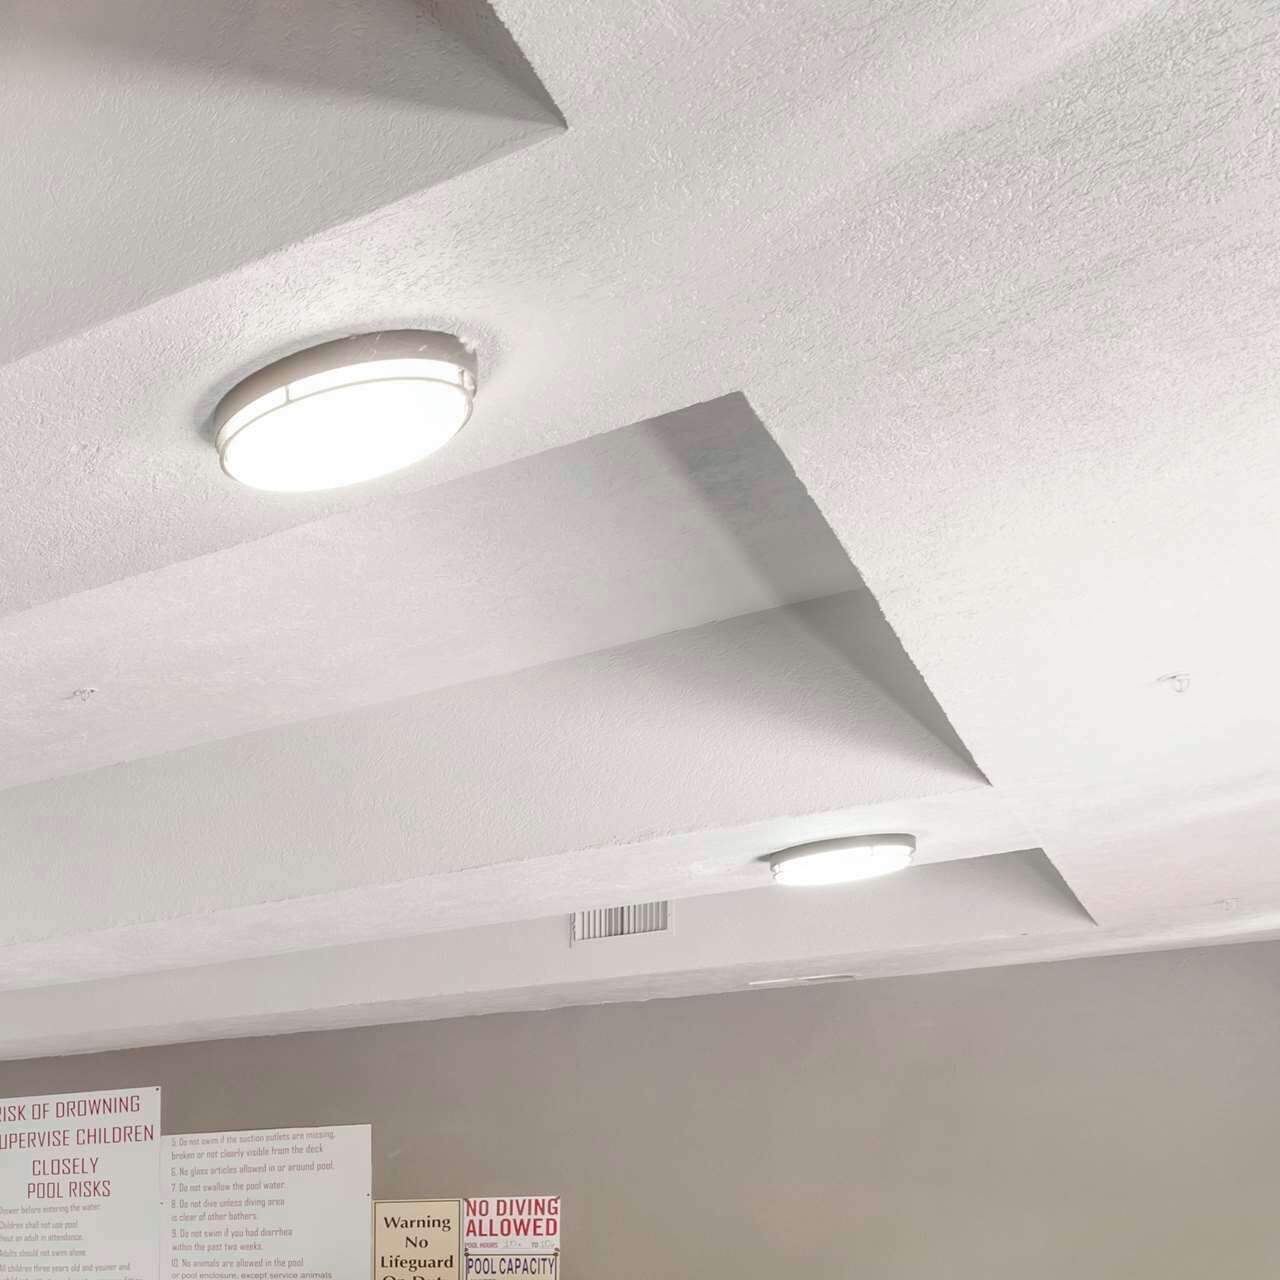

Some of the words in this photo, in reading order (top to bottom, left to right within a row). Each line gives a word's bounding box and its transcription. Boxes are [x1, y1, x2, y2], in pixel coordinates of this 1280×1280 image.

[32, 1103, 50, 1120] OF
[56, 1095, 140, 1118] DROWNING
[77, 1125, 154, 1145] CHILDREN
[171, 1151, 195, 1160] broken
[207, 1150, 218, 1158] not
[220, 1148, 244, 1159] clearly
[246, 1147, 269, 1157] visible
[271, 1147, 290, 1155] from
[291, 1145, 303, 1154] the
[32, 1157, 99, 1176] CLOSELY
[277, 1164, 286, 1172] or
[288, 1161, 314, 1171] around
[28, 1182, 63, 1199] POOL
[69, 1180, 111, 1197] RISKS
[190, 1183, 201, 1191] not
[232, 1181, 244, 1191] the
[246, 1180, 261, 1191] pool
[190, 1199, 201, 1208] not
[466, 1200, 489, 1216] NO
[496, 1198, 558, 1216] DIVING
[384, 1215, 451, 1232] Warning
[465, 1218, 558, 1237] ALLOWED
[190, 1229, 202, 1237] not
[231, 1229, 244, 1239] you
[245, 1227, 259, 1237] had
[405, 1236, 428, 1248] No
[274, 1257, 286, 1267] the
[287, 1257, 304, 1268] pool
[381, 1255, 453, 1272] Lifeguard
[467, 1258, 497, 1275] POOL
[499, 1257, 555, 1275] CAPACITY
[181, 1271, 197, 1280] pool
[240, 1272, 267, 1280] except
[300, 1271, 333, 1280] animals
